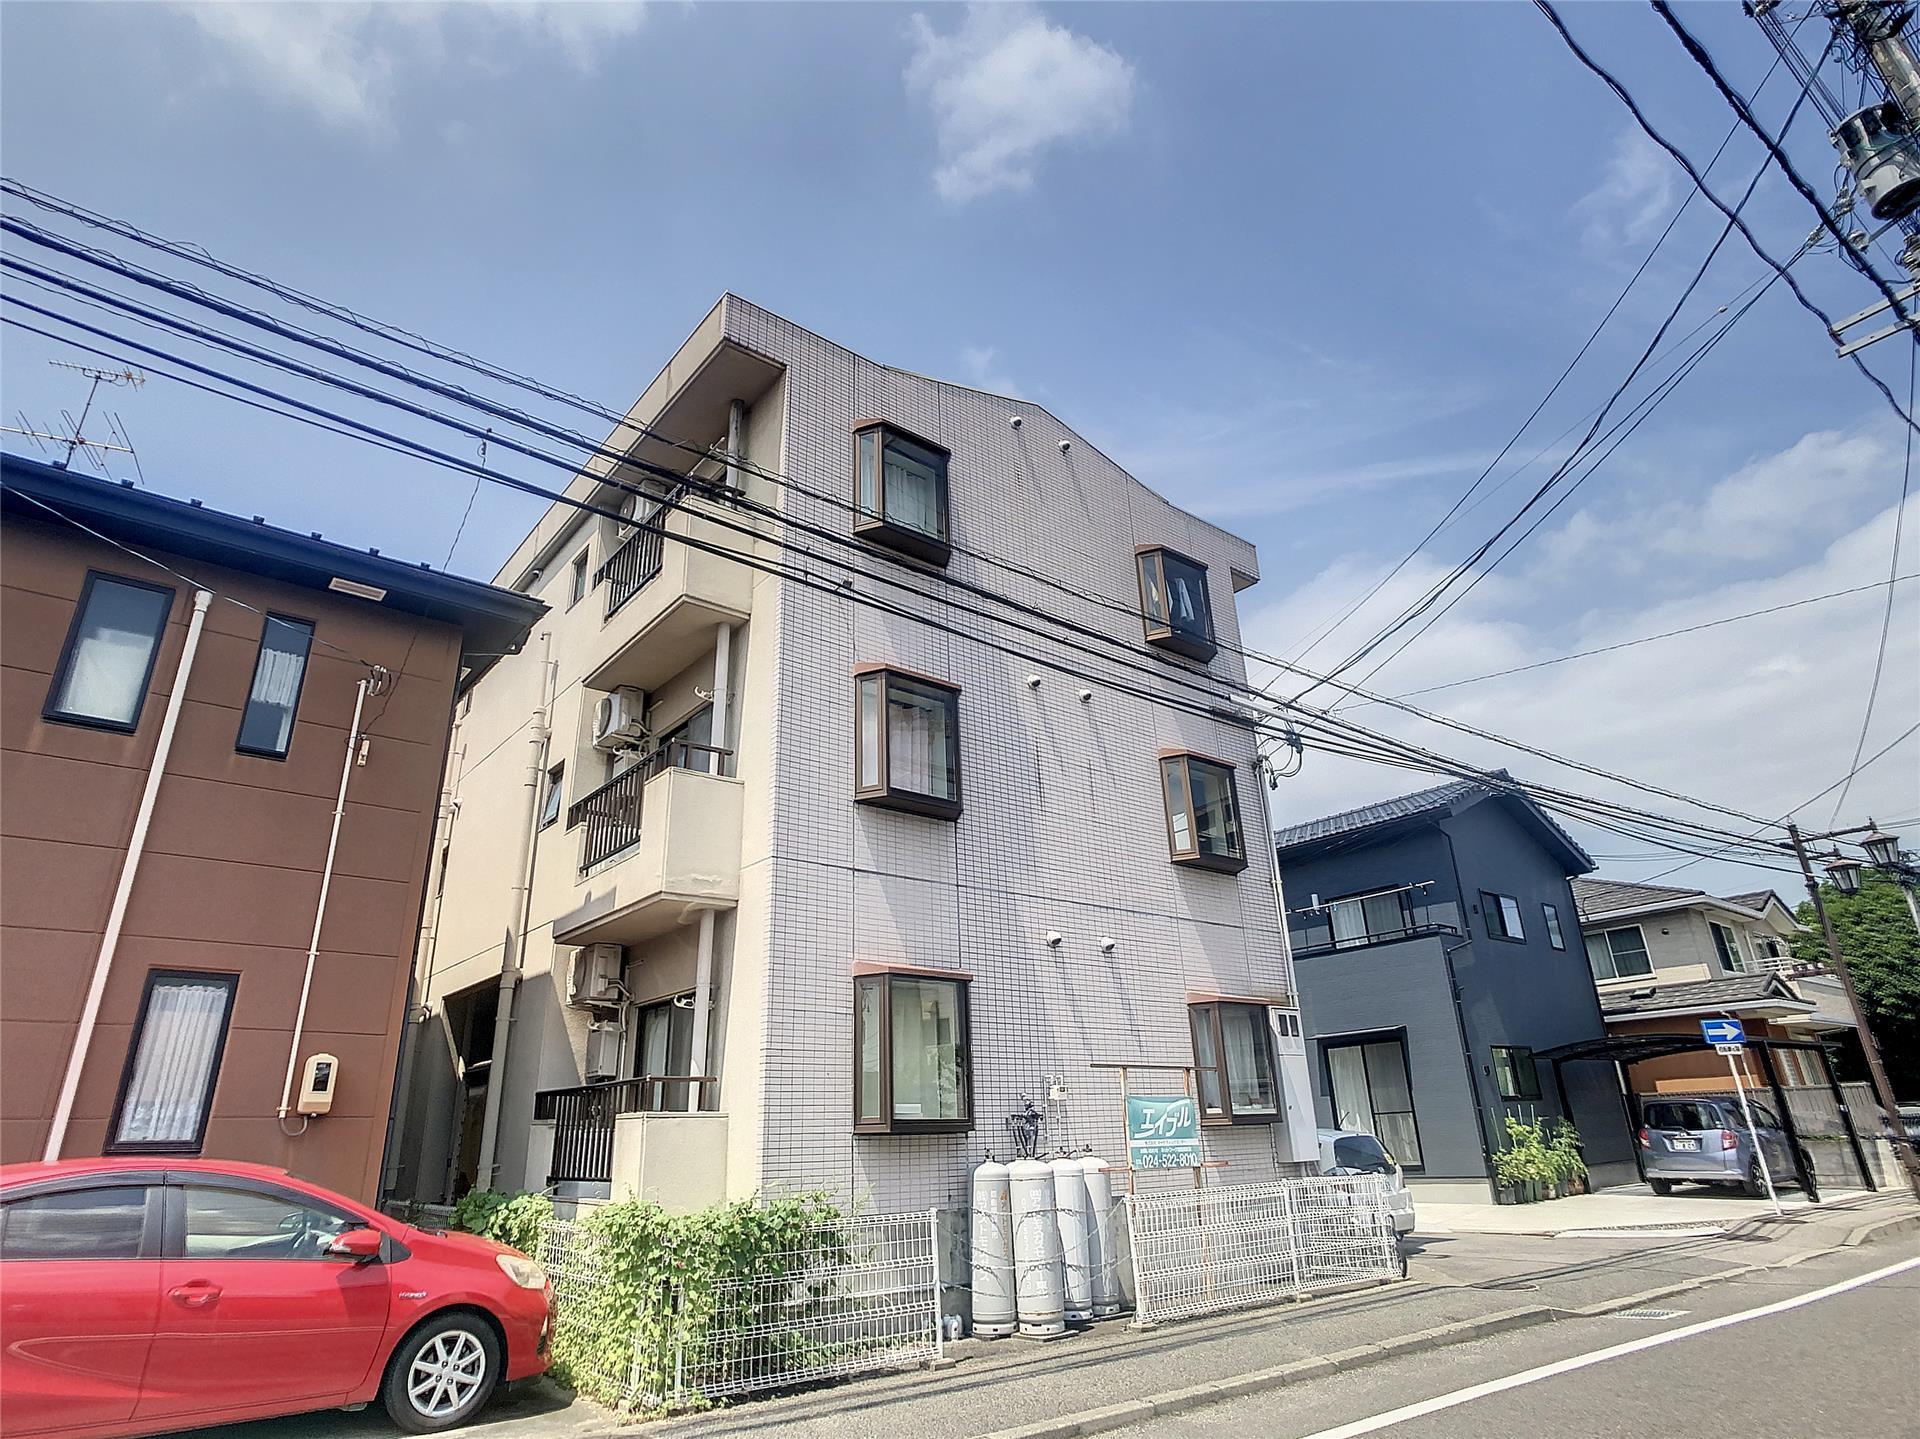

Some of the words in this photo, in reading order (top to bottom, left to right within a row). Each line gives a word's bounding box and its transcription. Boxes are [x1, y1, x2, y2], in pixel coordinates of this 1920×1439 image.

[1134, 1099, 1191, 1138] エイブル
[1142, 1153, 1197, 1168] 024-522-8010
